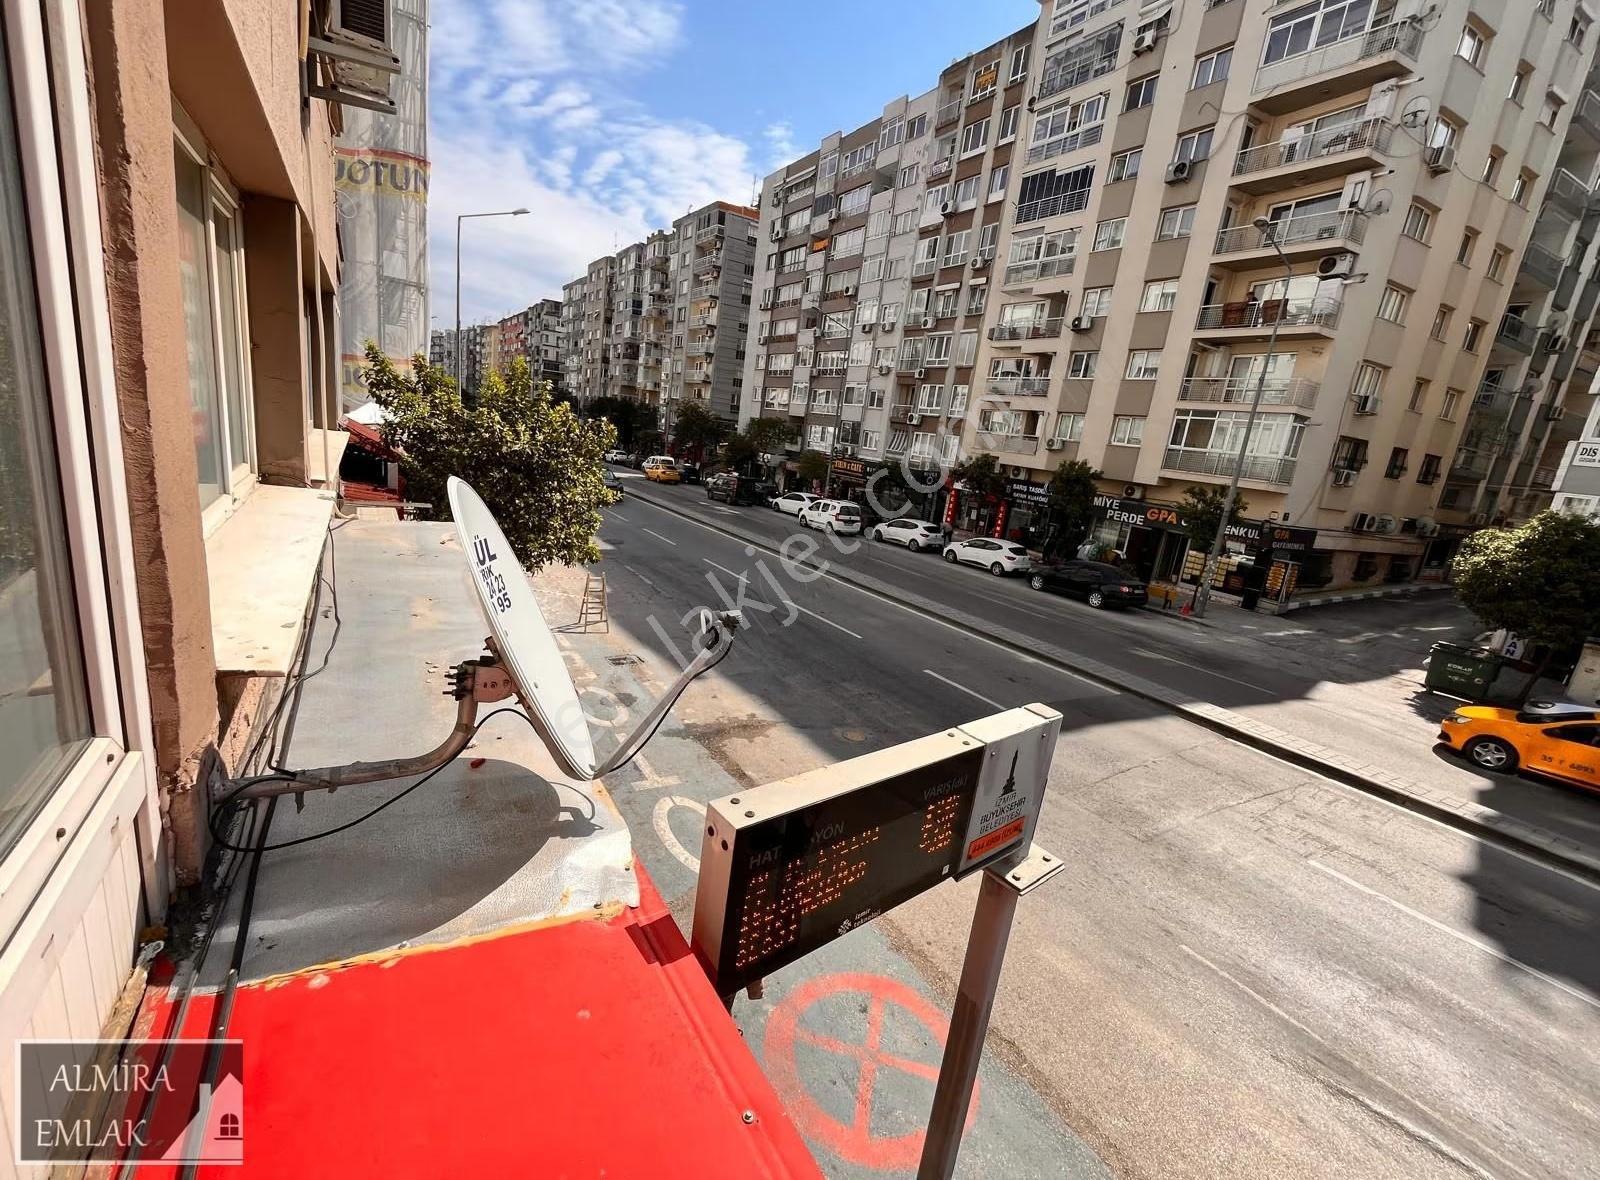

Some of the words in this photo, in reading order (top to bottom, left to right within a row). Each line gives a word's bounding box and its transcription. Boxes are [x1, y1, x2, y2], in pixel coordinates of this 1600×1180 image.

[336, 158, 430, 194] JOTUN
[1106, 509, 1145, 525] PERDE
[1146, 508, 1178, 525] GPA
[494, 574, 506, 594] 23
[750, 845, 782, 868] HAT
